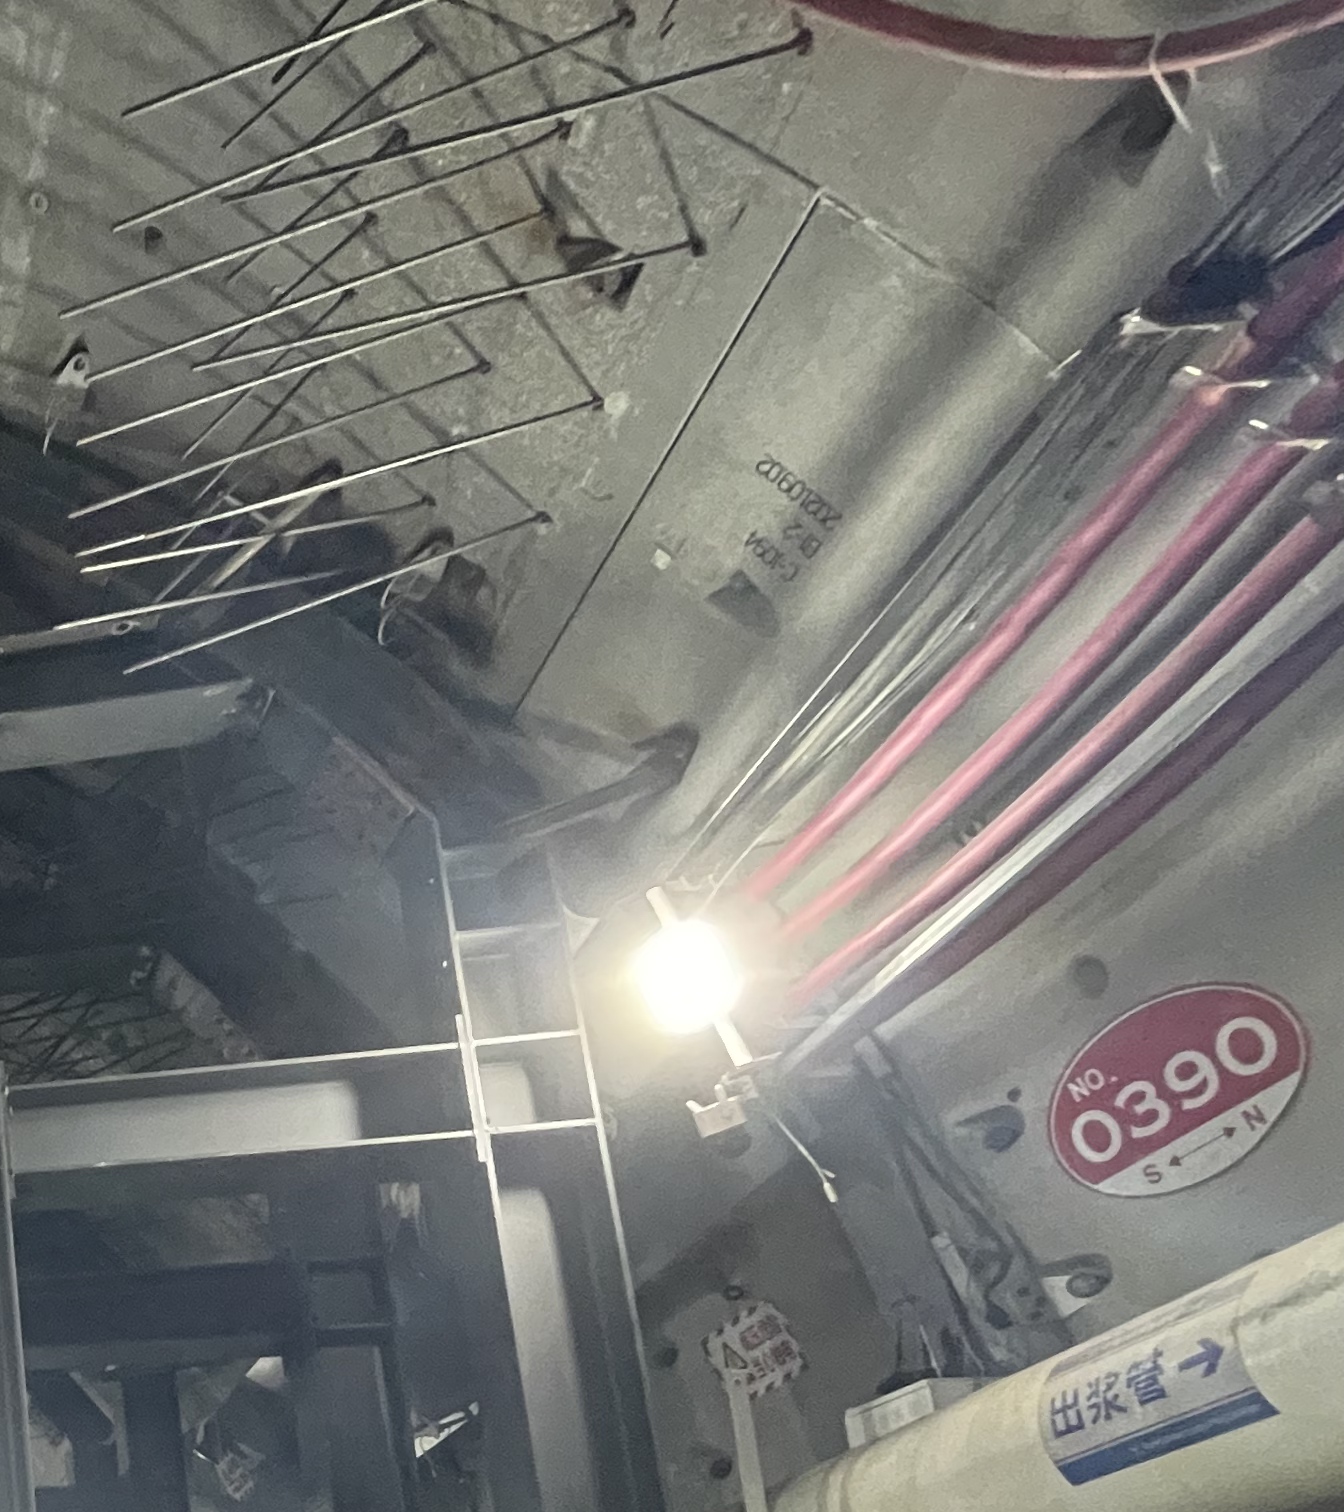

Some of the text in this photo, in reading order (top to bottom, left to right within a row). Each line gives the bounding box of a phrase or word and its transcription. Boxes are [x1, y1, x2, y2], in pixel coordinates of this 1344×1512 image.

[1070, 1016, 1279, 1164] 0390
[1142, 1105, 1267, 1185] S N
[1050, 1346, 1168, 1439] 出浆管
